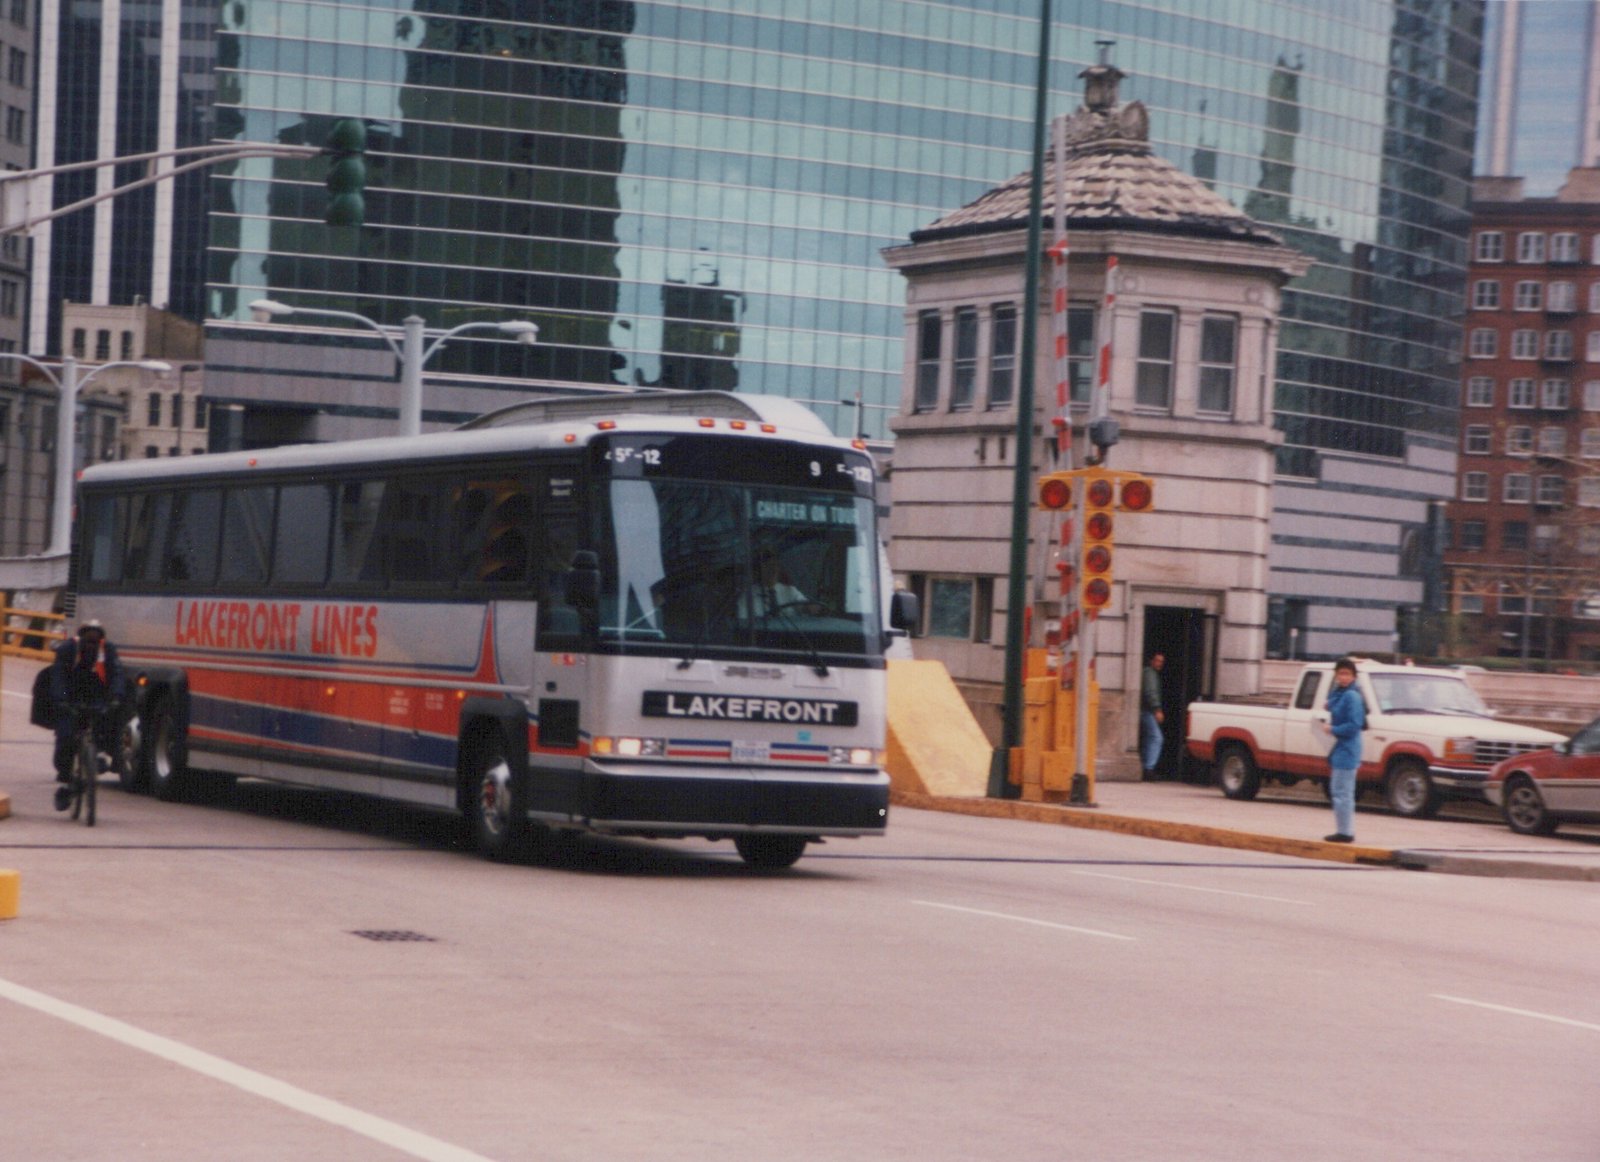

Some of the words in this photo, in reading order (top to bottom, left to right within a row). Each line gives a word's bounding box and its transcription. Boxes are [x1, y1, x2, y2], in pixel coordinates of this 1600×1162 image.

[176, 600, 302, 652] LAKEFRONT
[311, 605, 378, 657] LINES
[666, 695, 838, 722] LAKEFRONT
